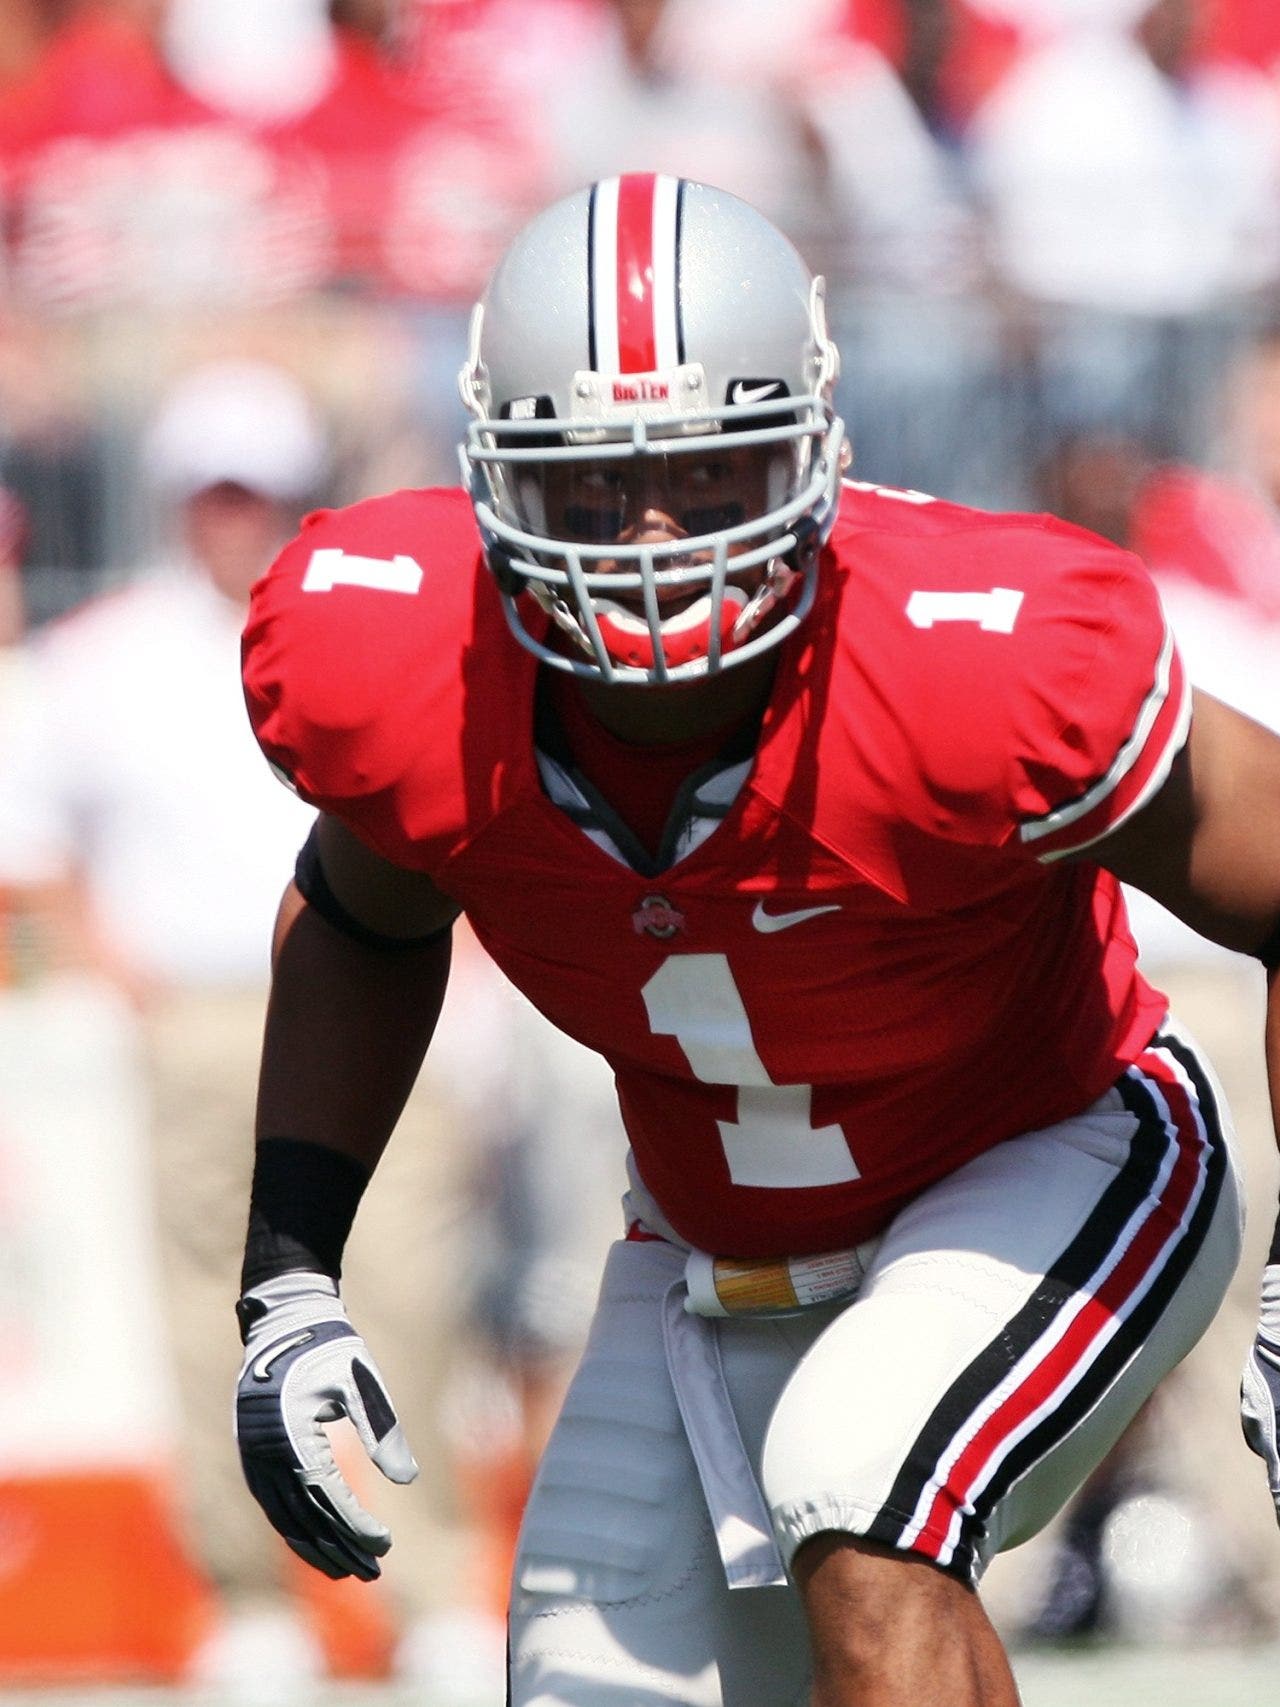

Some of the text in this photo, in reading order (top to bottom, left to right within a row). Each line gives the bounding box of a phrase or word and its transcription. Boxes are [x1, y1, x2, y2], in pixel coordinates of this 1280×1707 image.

[302, 548, 424, 595] 1
[904, 586, 1025, 635] 1
[641, 953, 861, 1188] 1
